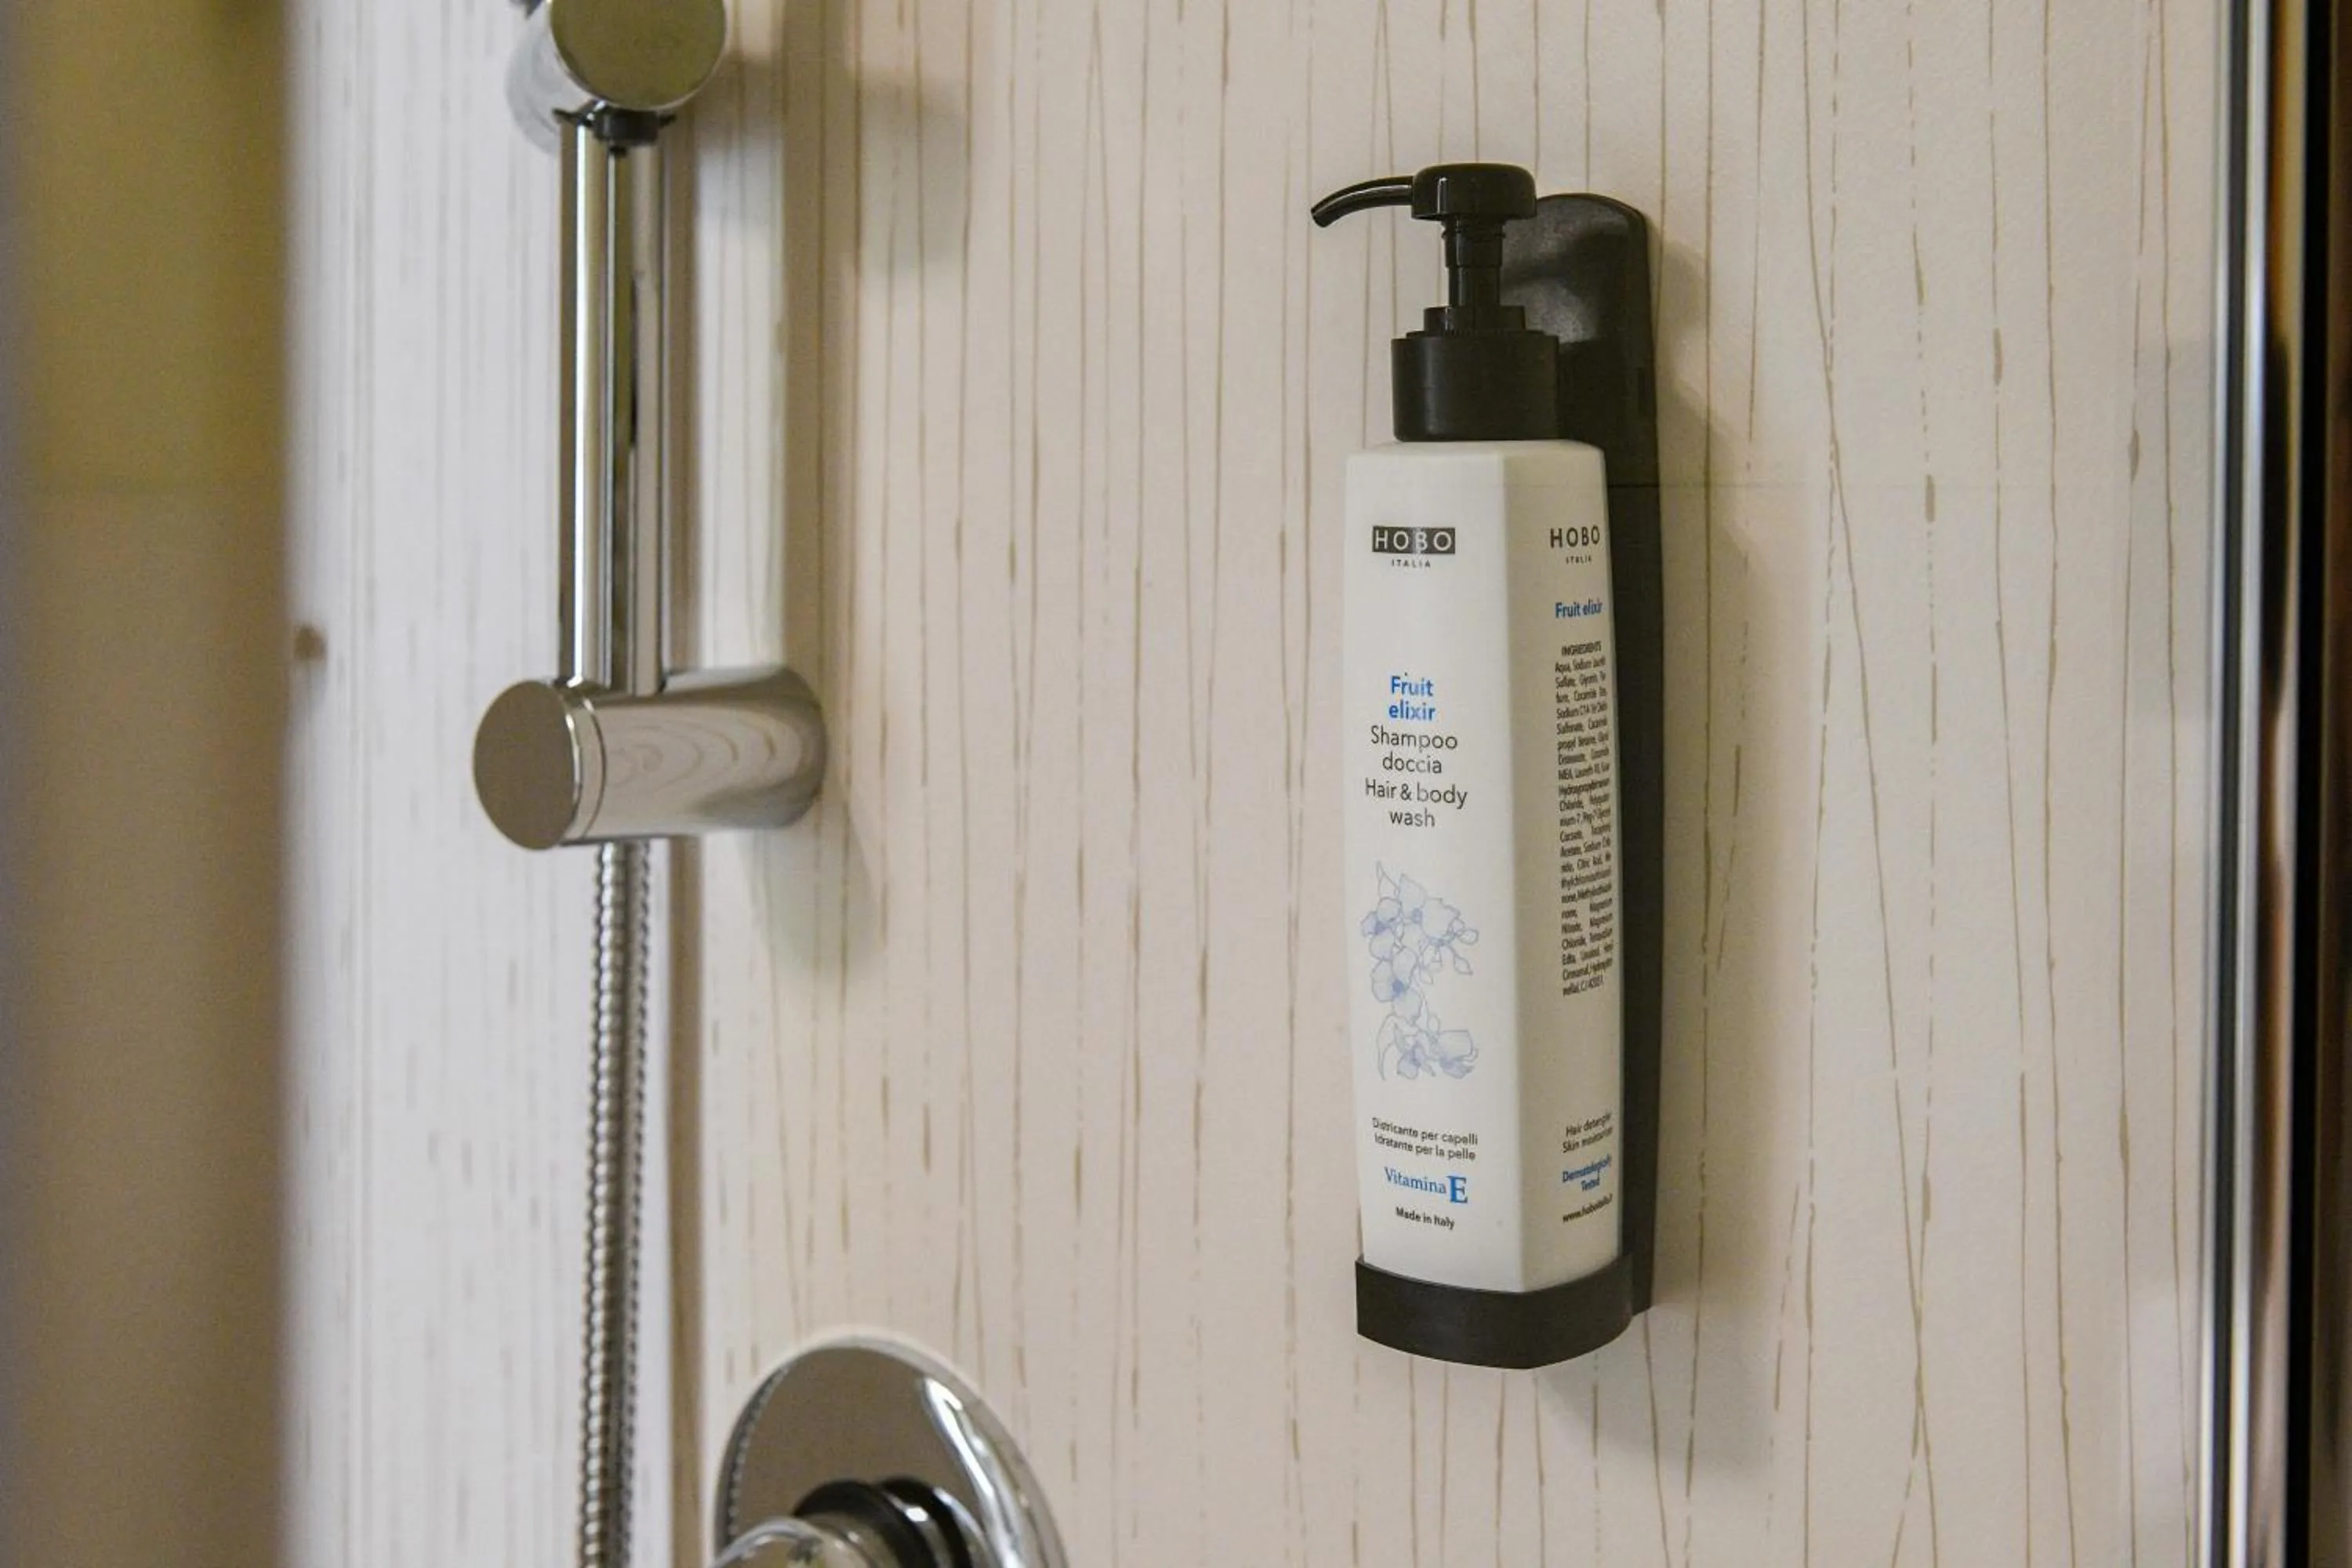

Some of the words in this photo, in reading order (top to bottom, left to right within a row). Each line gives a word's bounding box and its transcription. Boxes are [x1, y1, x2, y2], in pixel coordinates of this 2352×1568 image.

[1375, 529, 1452, 552] HOBO
[1550, 525, 1600, 549] HOBO
[1391, 559, 1432, 568] ITALIA
[1566, 554, 1593, 564] ITALIA
[1555, 601, 1581, 618] Fruit
[1582, 597, 1602, 615] elixir
[1391, 674, 1434, 697] Fruit
[1388, 699, 1436, 721] elixir
[1370, 724, 1458, 753] Shampoo
[1382, 750, 1442, 774] doccia
[1365, 777, 1398, 799] Hair
[1400, 782, 1412, 801] &
[1417, 781, 1468, 810] body
[1389, 807, 1436, 828] wash
[1372, 1116, 1418, 1138] Districante
[1421, 1131, 1439, 1142] per
[1441, 1131, 1479, 1149] capelli
[1374, 1131, 1414, 1152] Idratante
[1415, 1145, 1433, 1156] per
[1436, 1144, 1445, 1158] la
[1447, 1147, 1477, 1162] pelle
[1384, 1166, 1447, 1195] Vitamina
[1446, 1174, 1468, 1204] E
[1395, 1206, 1421, 1222] Made
[1423, 1211, 1432, 1224] in
[1434, 1214, 1455, 1231] Italy
